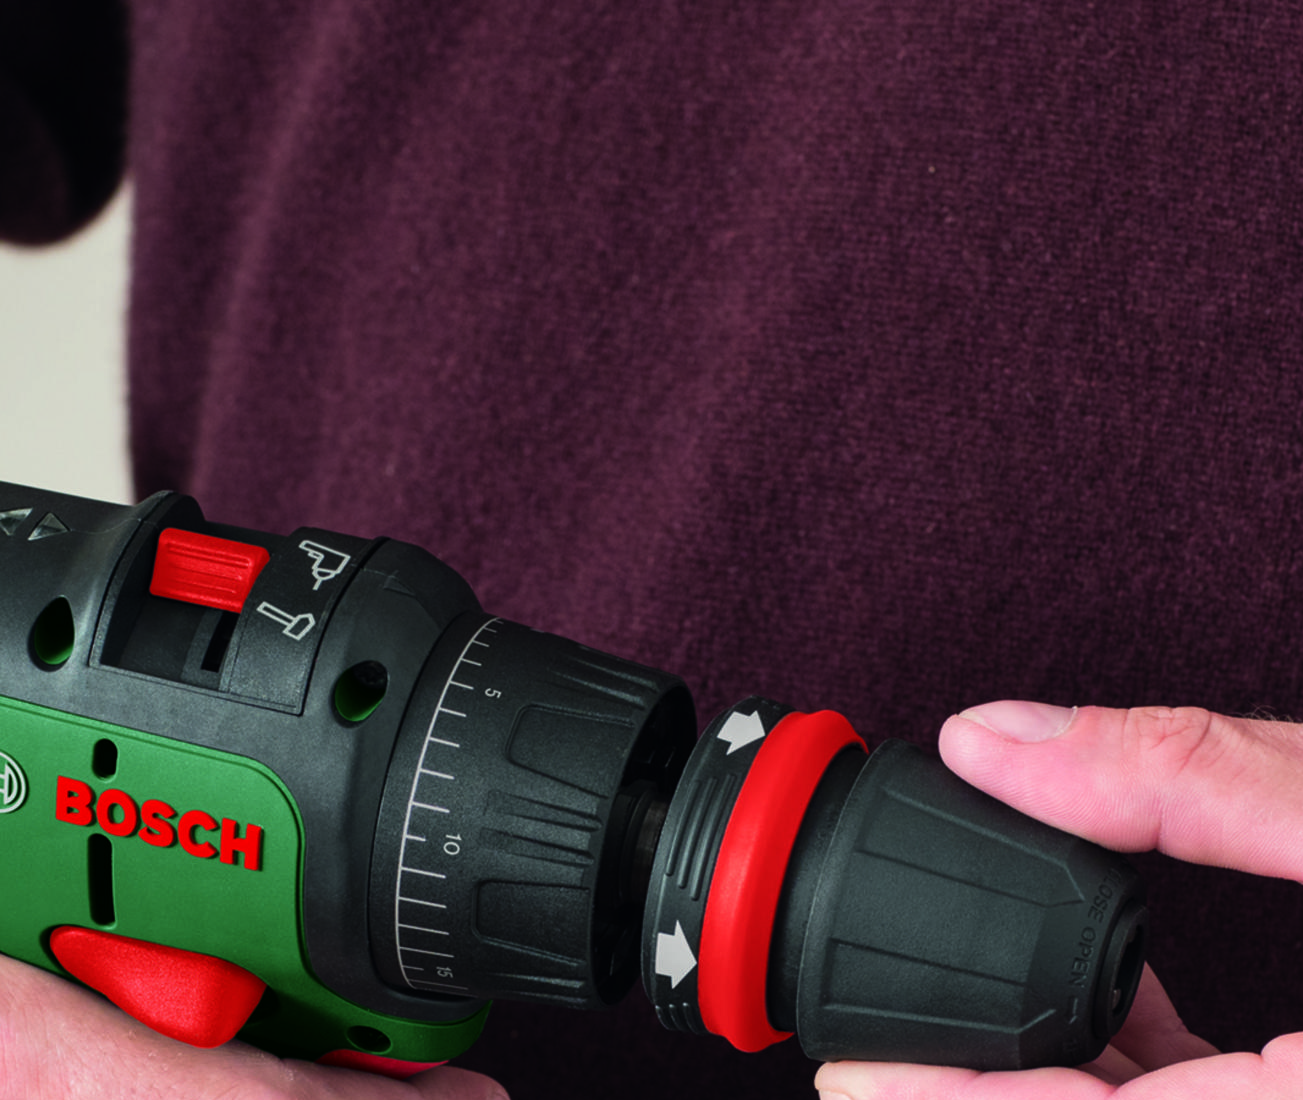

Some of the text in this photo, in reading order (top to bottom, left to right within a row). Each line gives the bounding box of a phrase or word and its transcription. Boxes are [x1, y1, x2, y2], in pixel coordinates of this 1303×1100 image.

[484, 688, 501, 699] 5
[56, 775, 262, 872] BOSCH
[443, 834, 462, 856] 10
[1069, 927, 1097, 989] OPEN
[436, 967, 454, 979] 15
